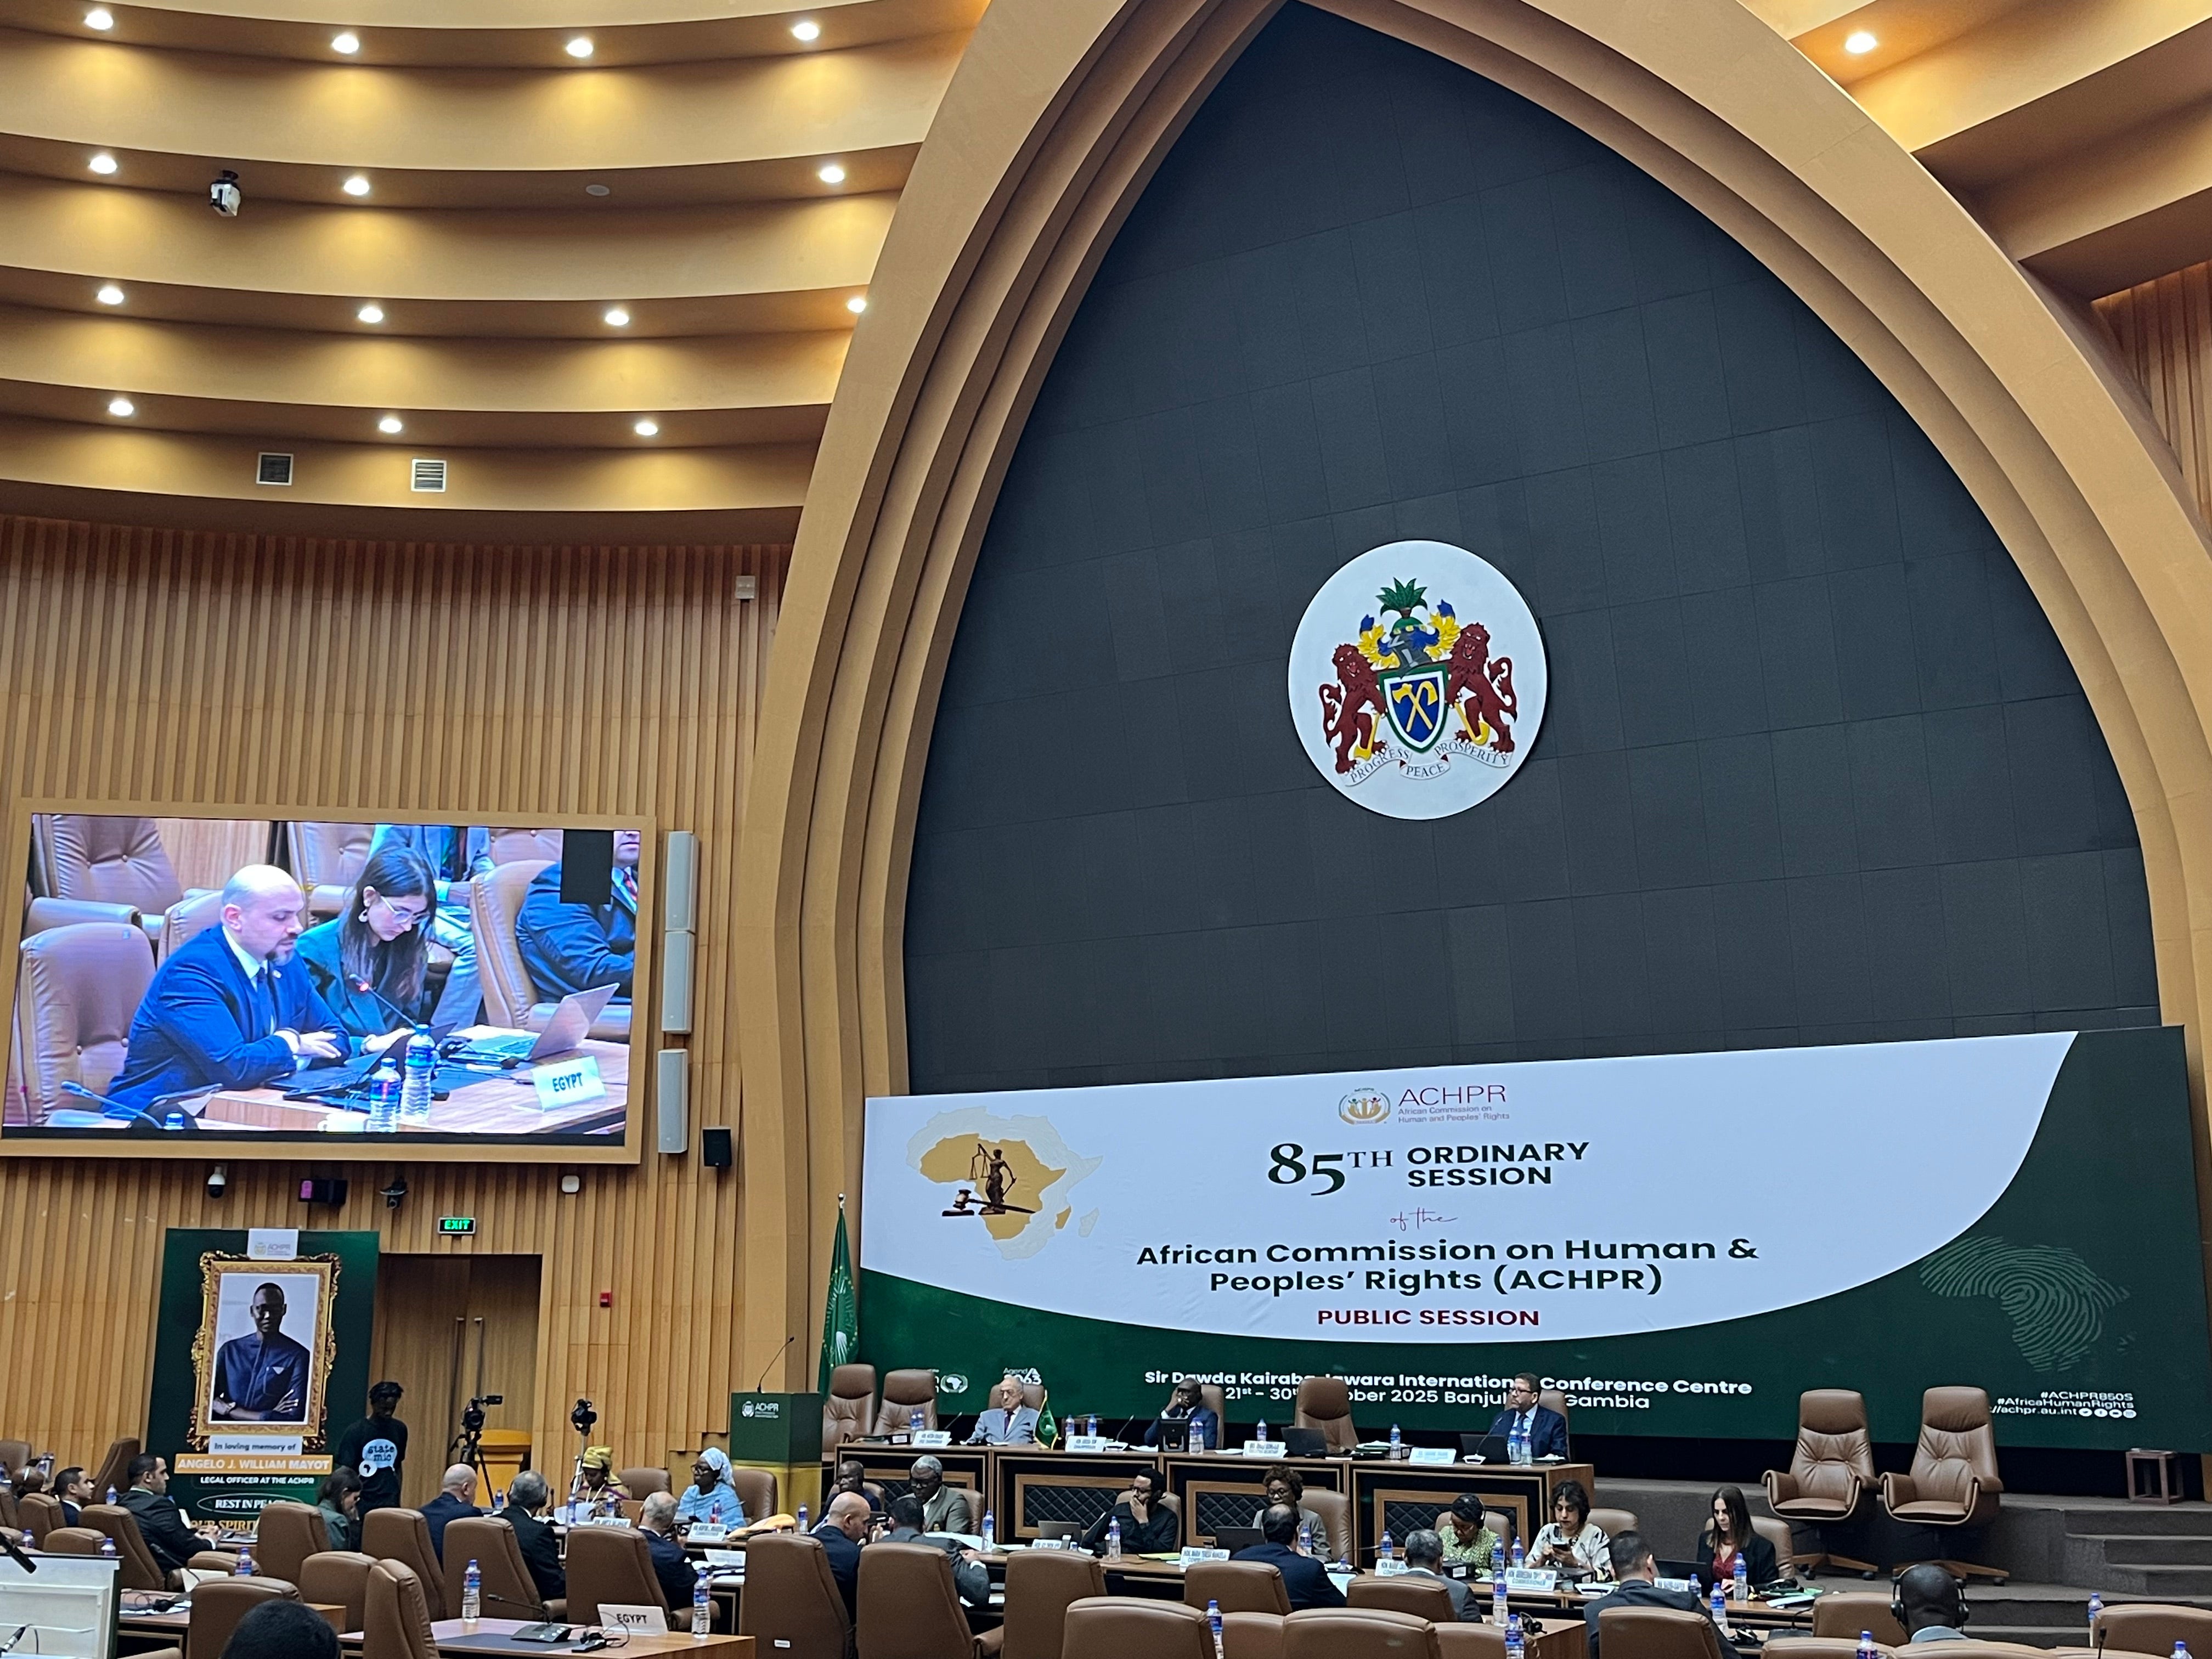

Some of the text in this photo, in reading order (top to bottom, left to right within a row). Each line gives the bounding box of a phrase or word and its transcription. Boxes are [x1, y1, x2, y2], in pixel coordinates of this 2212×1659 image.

[1434, 742, 1509, 766] PROSPERITY
[1351, 748, 1410, 783] PROGRESS
[1406, 761, 1446, 777] PEACE
[552, 1072, 583, 1092] EGYPT
[1398, 1085, 1506, 1107] ACHPR
[1398, 1106, 1427, 1115] African
[1429, 1105, 1479, 1114] Commission
[1398, 1115, 1426, 1123] Human
[1446, 1113, 1481, 1122] Peoples'
[1483, 1112, 1510, 1121] Rights
[1407, 1142, 1589, 1165] ORDINARY
[1407, 1166, 1551, 1187] SESSION
[444, 1220, 470, 1229] EXIT
[1390, 1207, 1458, 1231] of the
[1137, 1238, 1759, 1265] African Commission on Human &
[1365, 1269, 1482, 1296] Rights
[1493, 1264, 1662, 1295] (ACHPR)
[1318, 1310, 1539, 1325] PUBLIC SESSION
[1145, 1370, 1169, 1384] Sir
[1172, 1372, 1236, 1384] Dwda
[1399, 1374, 1514, 1388] Internation
[1540, 1377, 1668, 1392] Conference
[1673, 1379, 1752, 1394] Centre
[1391, 1390, 1438, 1403] 2025
[1565, 1394, 1649, 1408] Gambia
[1997, 1398, 2134, 1409] #AfricaHumanRights
[225, 1442, 249, 1451] loving
[178, 1459, 330, 1470] ANGELO J. WILLIAM MAYOT
[215, 1499, 241, 1509] REST
[242, 1499, 253, 1509] IN
[616, 1613, 647, 1624] EGYPT
